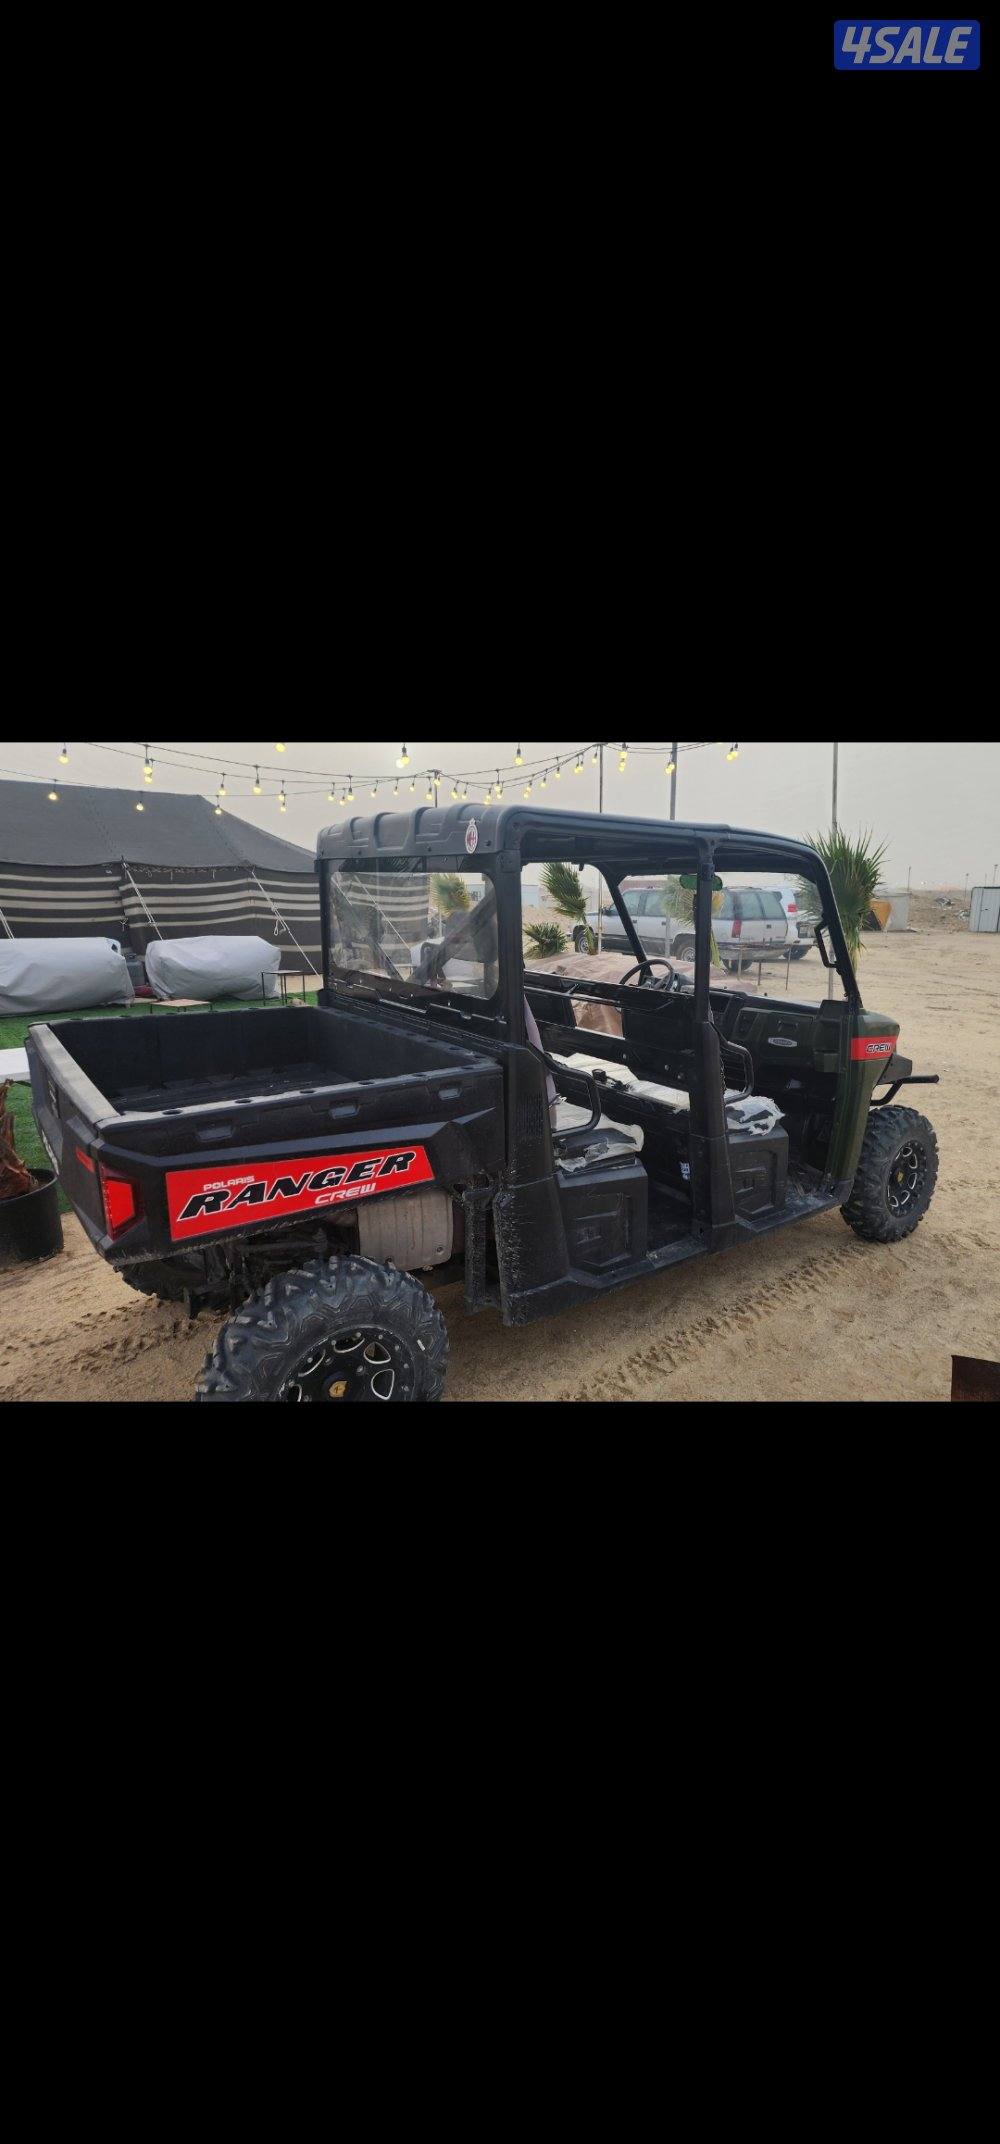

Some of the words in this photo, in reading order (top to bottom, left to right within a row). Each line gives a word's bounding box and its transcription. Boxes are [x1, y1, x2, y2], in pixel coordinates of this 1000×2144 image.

[177, 1151, 417, 1222] RANGER
[203, 1175, 255, 1192] POLARIS
[314, 1182, 377, 1205] CREW
